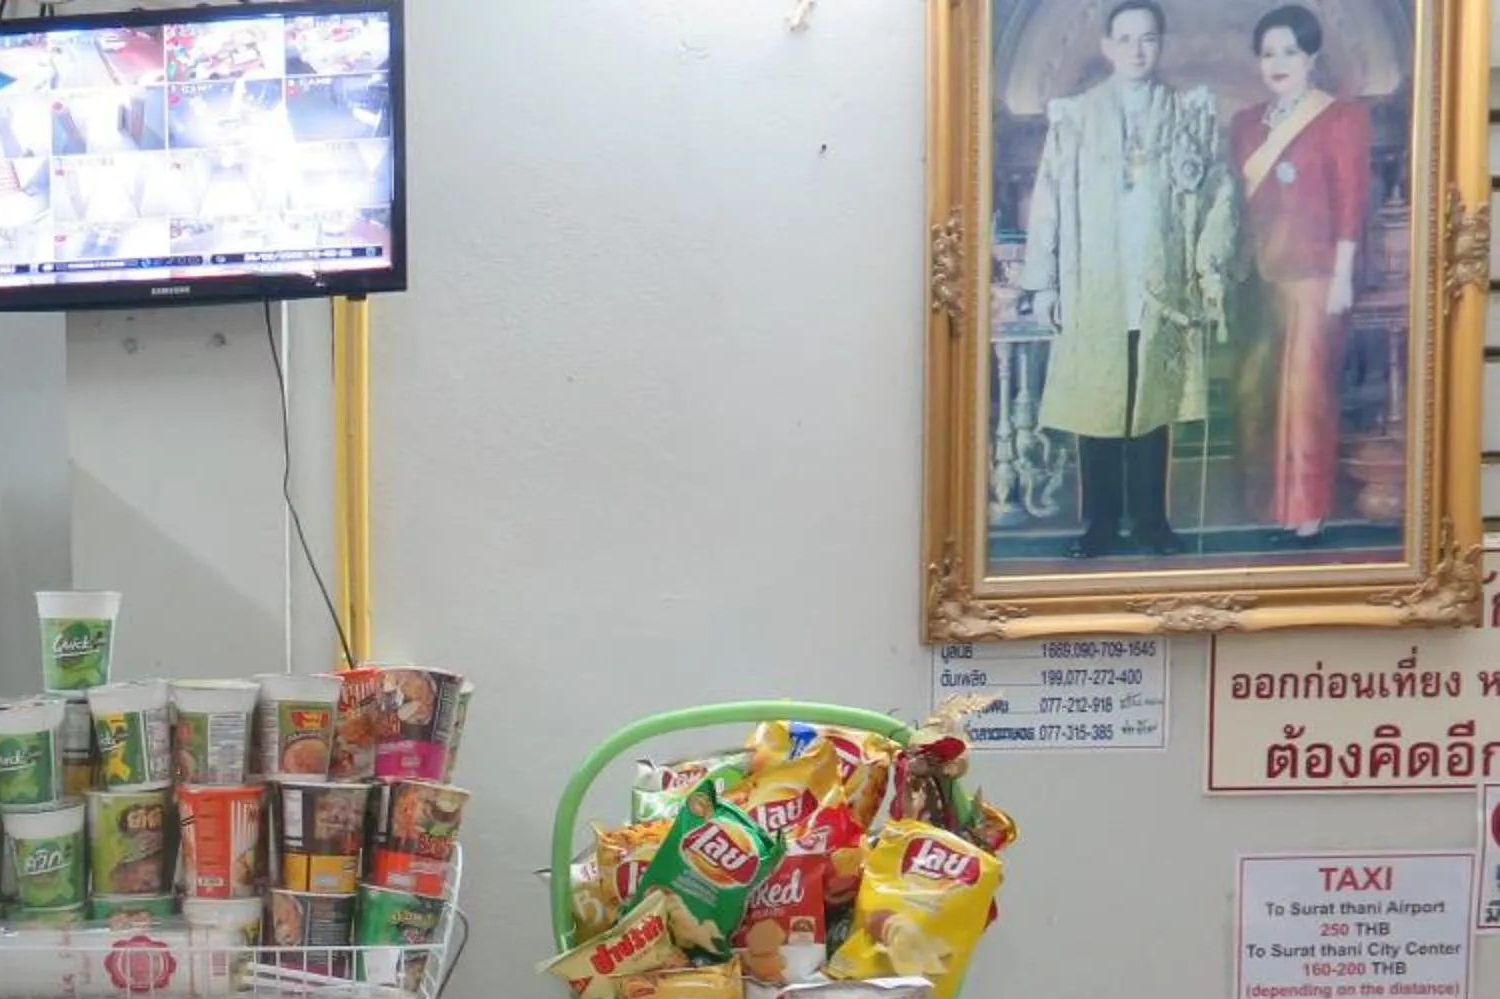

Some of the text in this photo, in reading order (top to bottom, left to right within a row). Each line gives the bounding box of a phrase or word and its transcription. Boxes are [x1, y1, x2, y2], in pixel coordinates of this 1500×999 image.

[1231, 646, 1461, 699] ออกก่อนเที่ยง
[1318, 866, 1394, 892] TAXI
[1265, 900, 1446, 916] To Surat thani Airport
[1320, 921, 1391, 937] 250 THB
[1245, 941, 1462, 959] To Surat thani City Center
[1303, 961, 1408, 977] 160-200 THB
[1245, 981, 1461, 999] (depending on the distance)
